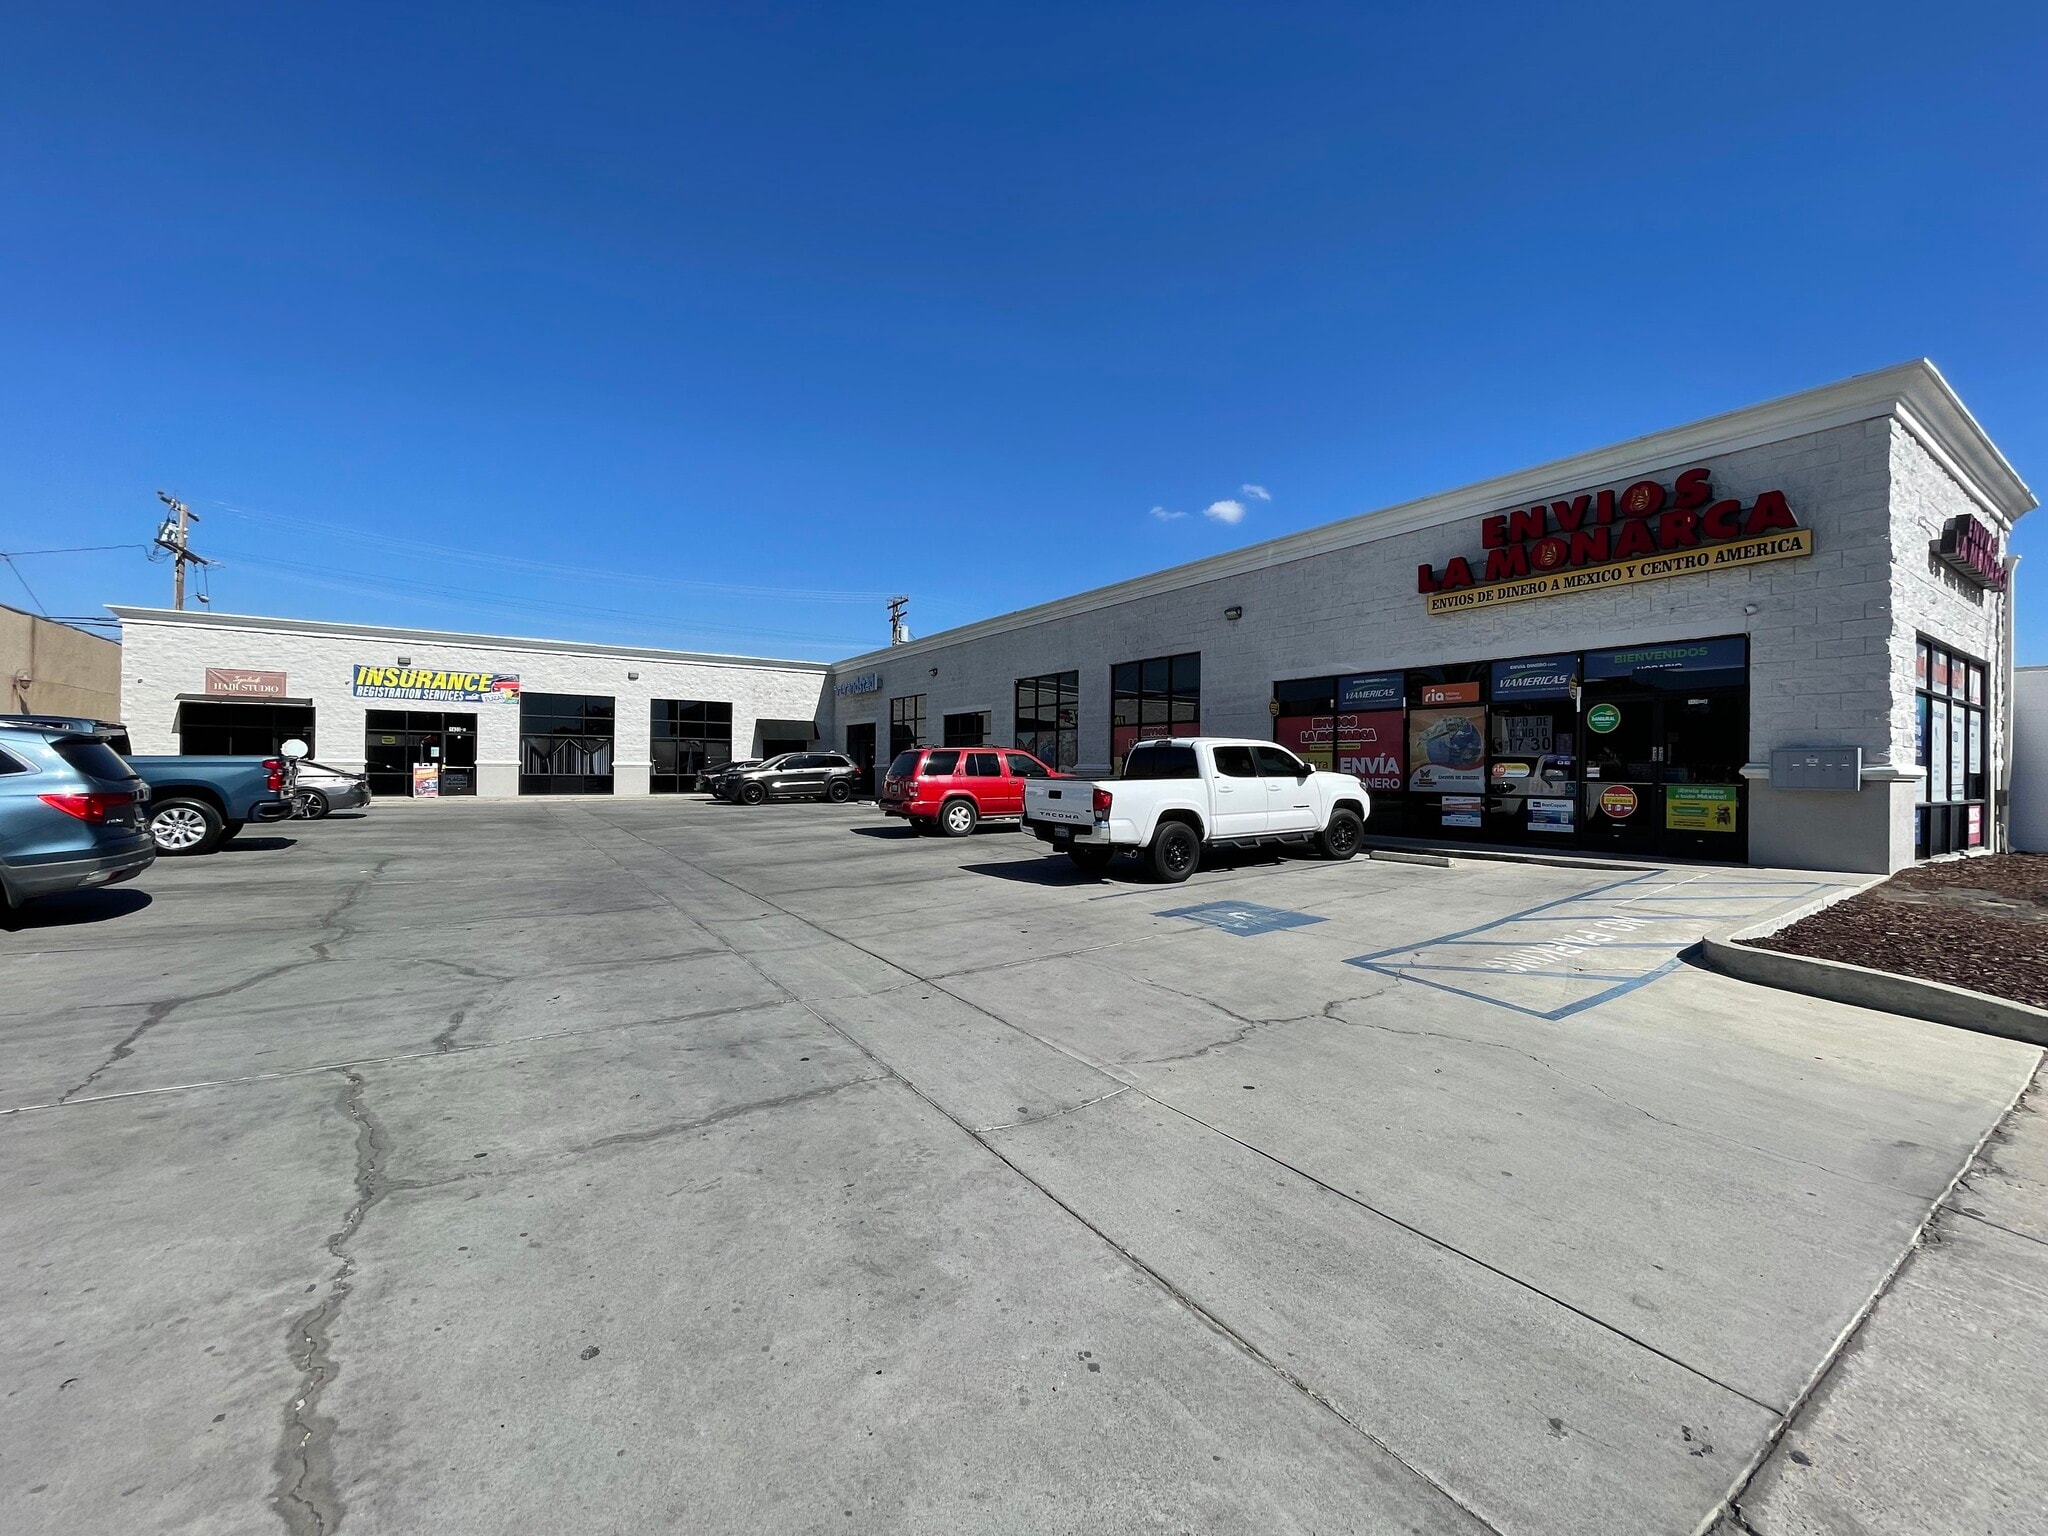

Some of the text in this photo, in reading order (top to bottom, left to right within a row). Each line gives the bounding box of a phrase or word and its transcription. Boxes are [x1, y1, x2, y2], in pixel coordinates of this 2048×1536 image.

[1482, 468, 1713, 550] ENVIOS
[1418, 490, 1799, 594] LA MONARCA
[1432, 536, 1803, 610] ENVIOS DE DINERO A MEXICO Y CENTRO AMERICA
[1614, 647, 1708, 664] BIENVENIDOS
[356, 666, 493, 692] INSURANCE
[1500, 674, 1569, 688] VIAMERICAS
[213, 682, 279, 693] HAIR STUDIO
[356, 685, 465, 702] REGISTRATION SERVICES
[1345, 688, 1395, 700] VIAMERICAS
[1425, 688, 1444, 702] ria
[1505, 716, 1548, 728] TIPO DE
[1509, 727, 1548, 738] CAMBIO
[1340, 752, 1400, 774] ENVÍA
[1040, 811, 1079, 820] TACOMA
